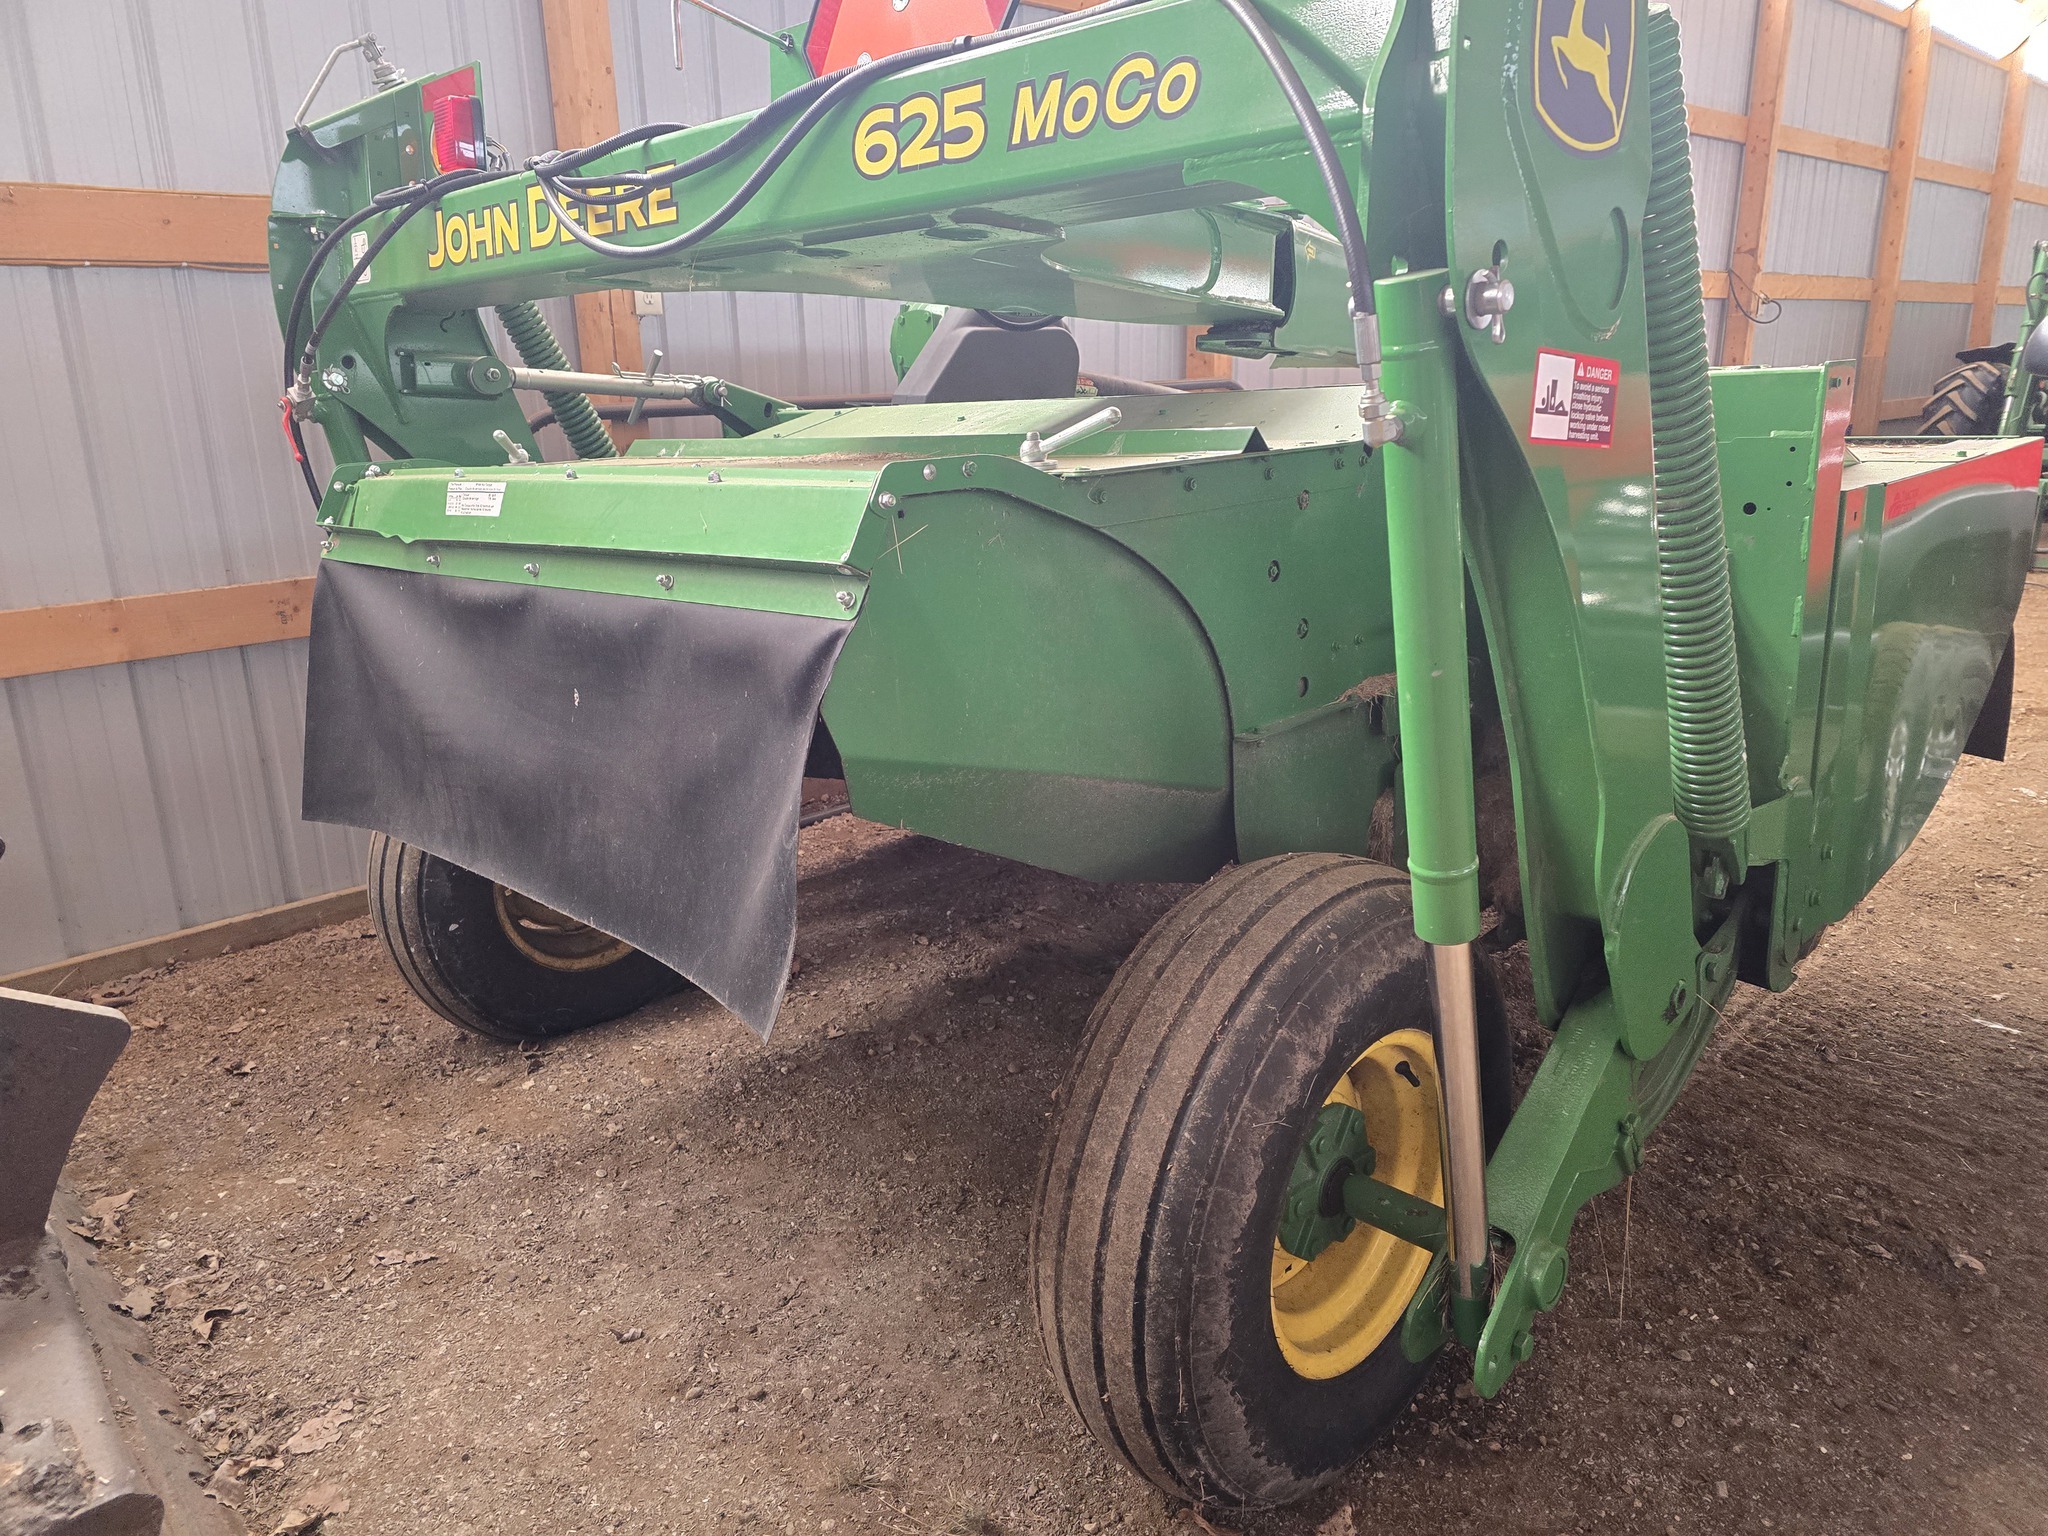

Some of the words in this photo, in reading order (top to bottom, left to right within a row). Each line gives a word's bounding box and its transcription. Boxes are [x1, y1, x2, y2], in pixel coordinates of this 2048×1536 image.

[853, 78, 988, 180] 625
[1007, 51, 1202, 151] MoCo
[428, 201, 521, 269] JOHN
[526, 160, 679, 250] DEERE
[1586, 365, 1612, 381] DANGER
[1574, 380, 1580, 390] To
[1580, 382, 1592, 392] avoid
[1595, 385, 1610, 394] serious
[1572, 392, 1591, 403] crushing
[1571, 401, 1583, 410] close
[1583, 402, 1602, 413] hydraulic
[1570, 410, 1585, 423] lockup
[1585, 412, 1596, 421] valve
[1596, 413, 1609, 423] before
[1569, 421, 1586, 432] working
[1586, 422, 1598, 431] under
[1598, 423, 1611, 433] raised
[1568, 430, 1590, 442] harvesting
